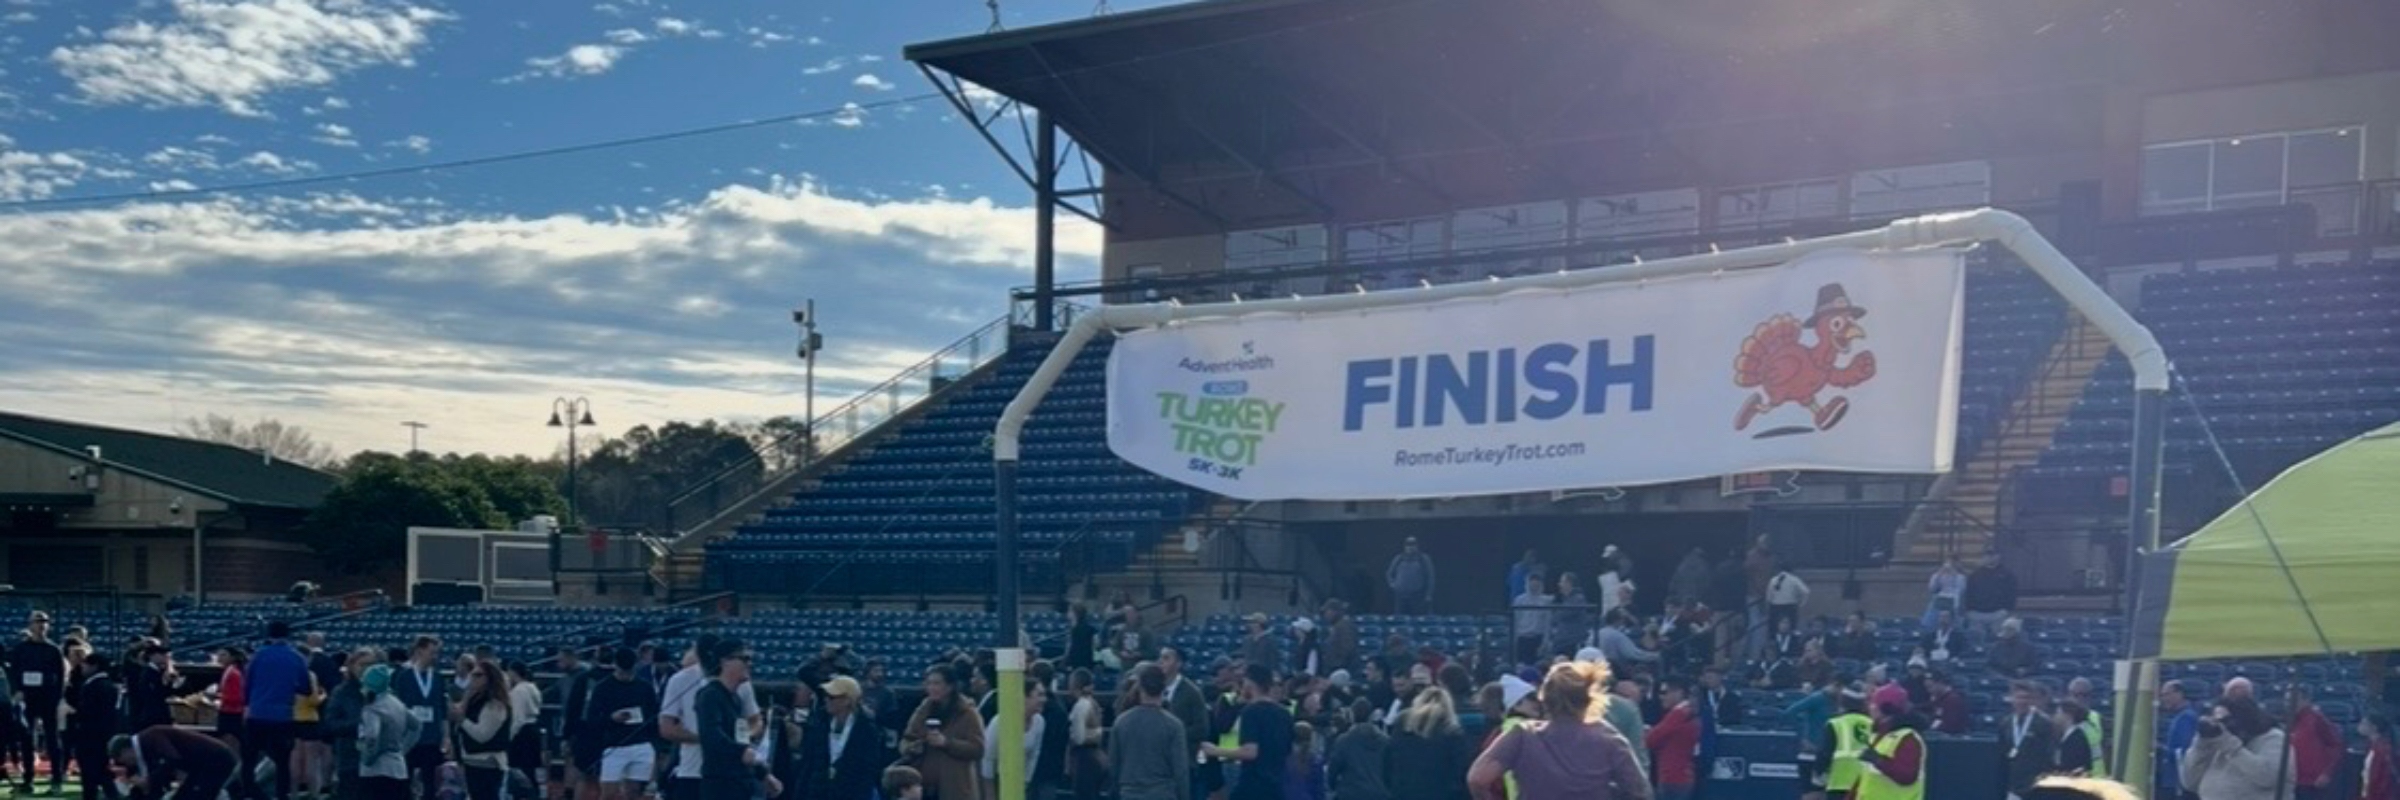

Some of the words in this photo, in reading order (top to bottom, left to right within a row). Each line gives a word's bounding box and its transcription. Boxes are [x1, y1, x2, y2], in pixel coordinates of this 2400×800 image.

[1343, 334, 1655, 432] FINISH
[1156, 391, 1285, 433] TURKEY
[1170, 423, 1263, 466] TROT
[1394, 442, 1586, 467] RomeTurkeyTrot.com
